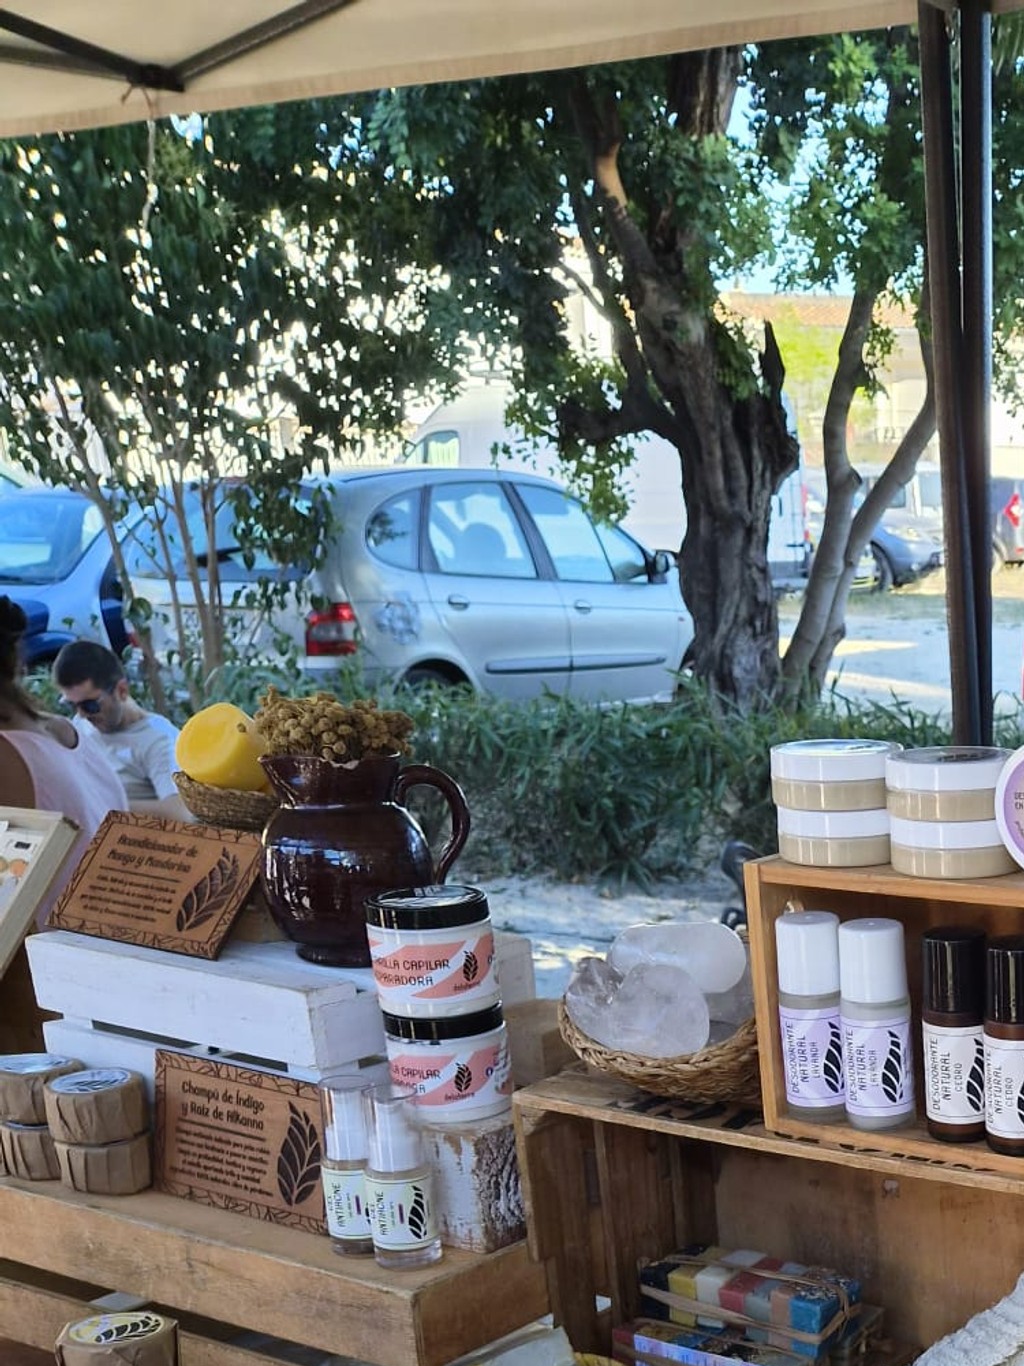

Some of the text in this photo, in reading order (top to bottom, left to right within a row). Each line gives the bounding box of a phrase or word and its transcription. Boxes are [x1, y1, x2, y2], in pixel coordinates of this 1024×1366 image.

[403, 957, 450, 971] CAPILAR
[401, 1066, 441, 1080] CAPILAR
[786, 1021, 800, 1093] DESODORANTE
[797, 1035, 809, 1083] NATURAL
[810, 1041, 820, 1079] LAVANDA
[846, 1027, 857, 1101] DESODORANTE
[856, 1044, 867, 1091] NATURAL
[868, 1049, 879, 1087] LAVANDA
[929, 1037, 941, 1110] DESODORANTE
[940, 1052, 952, 1101] NATURAL
[954, 1062, 963, 1093] CEDRO
[993, 1066, 1002, 1114] NATURAL
[1005, 1077, 1013, 1107] CEDRO
[182, 1102, 187, 1116] y
[212, 1105, 223, 1120] de
[222, 1088, 232, 1104] de
